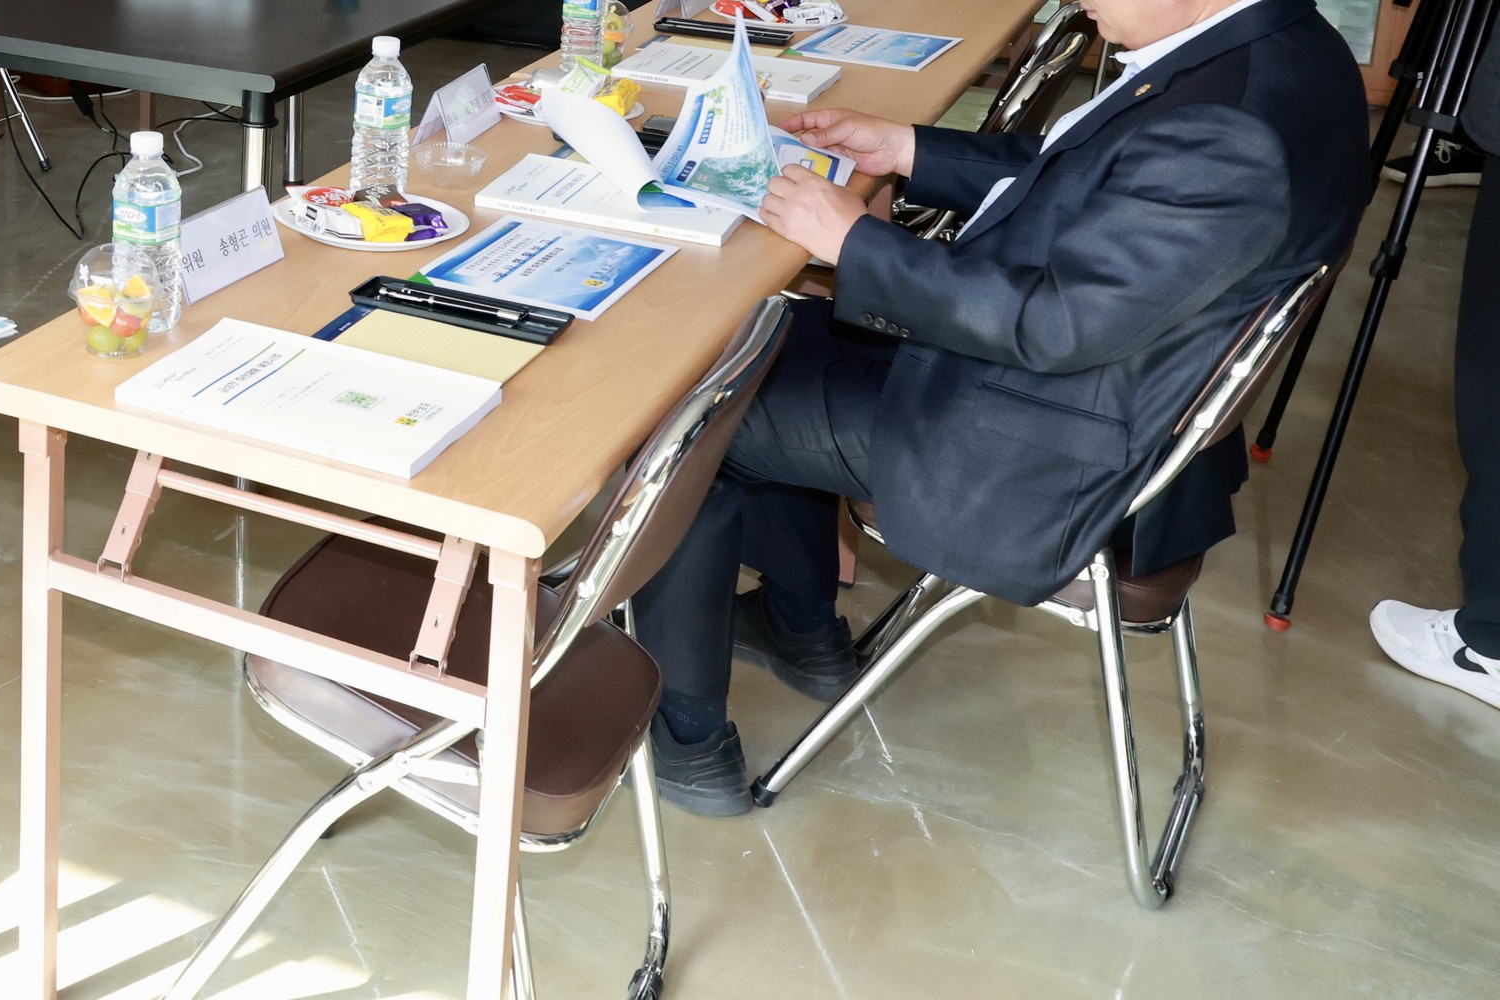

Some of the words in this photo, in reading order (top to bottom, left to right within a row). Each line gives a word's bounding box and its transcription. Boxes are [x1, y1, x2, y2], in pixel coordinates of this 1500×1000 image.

[182, 248, 205, 275] 위원
[219, 230, 249, 258] 송형곤
[252, 217, 273, 243] 의원
